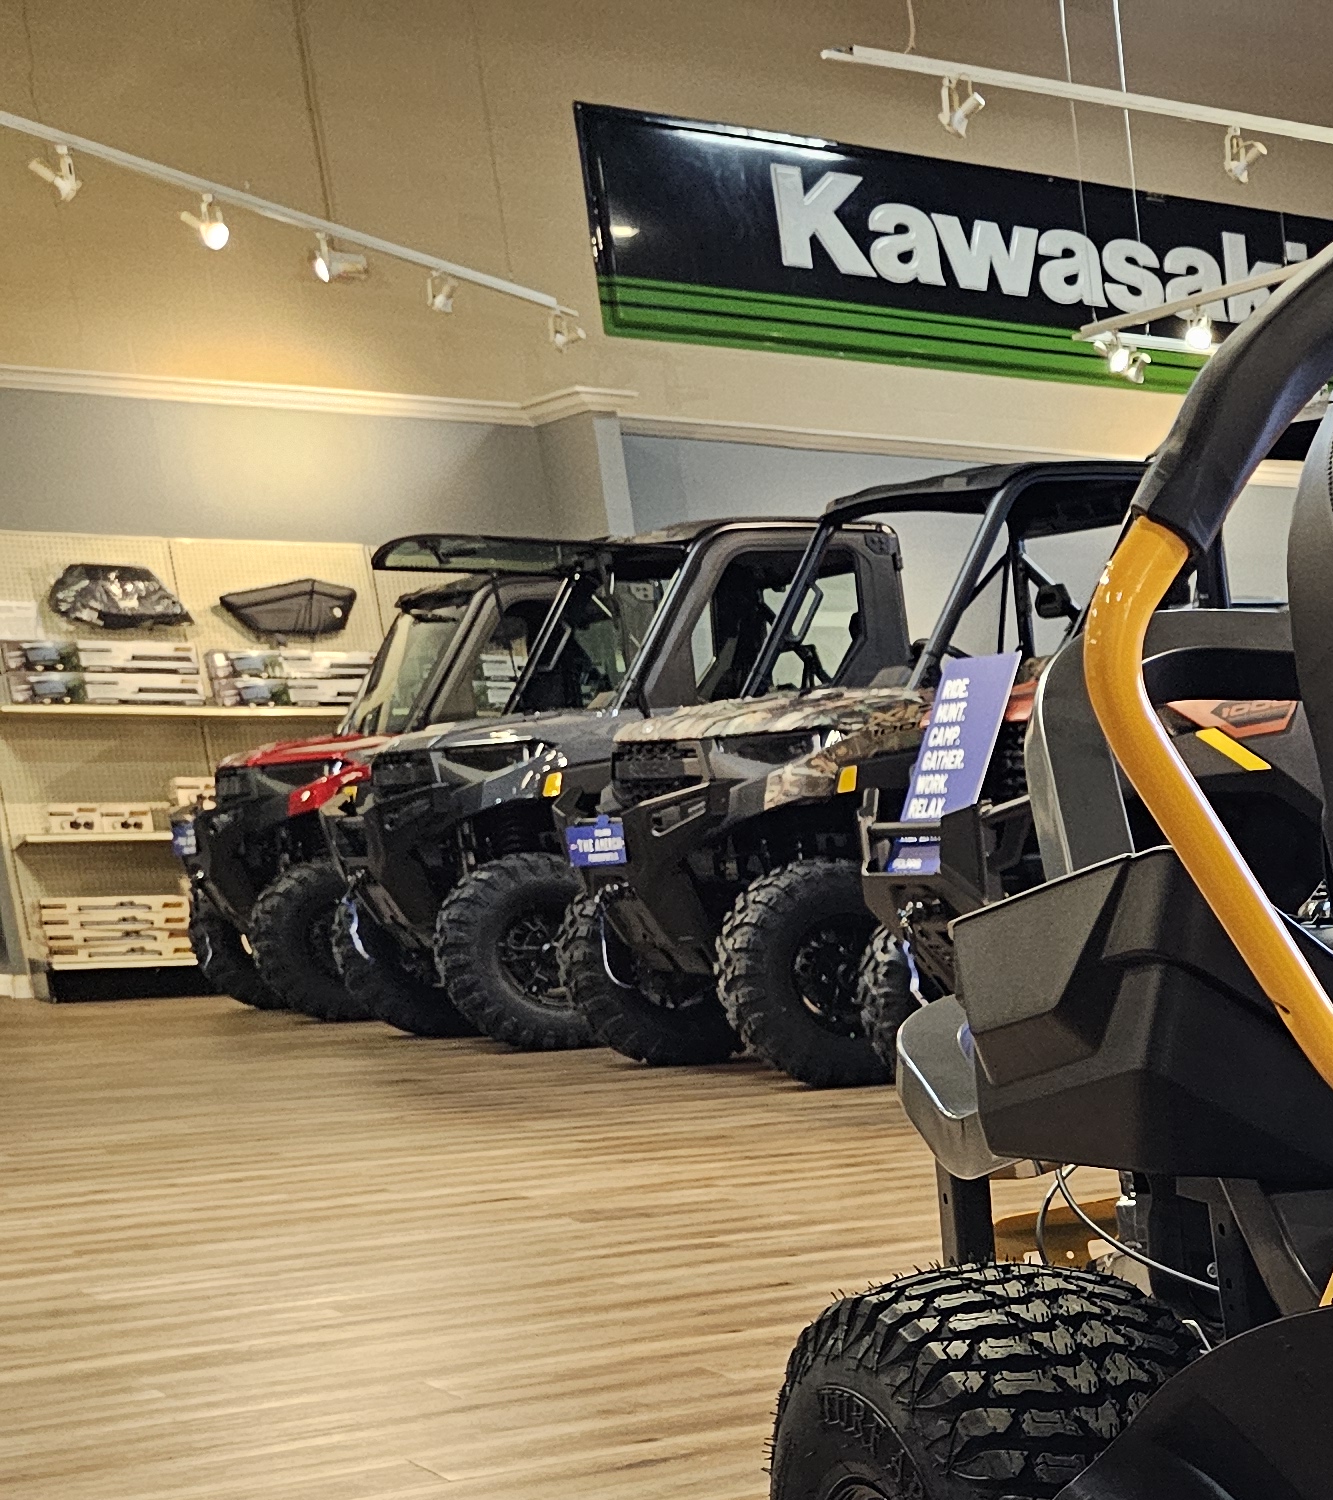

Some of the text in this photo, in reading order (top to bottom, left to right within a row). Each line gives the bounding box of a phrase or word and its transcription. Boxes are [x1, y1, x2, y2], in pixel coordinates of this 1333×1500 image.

[770, 163, 1308, 324] Kawasak
[942, 678, 970, 700] RIDE.
[935, 702, 966, 724] HUNT.
[928, 726, 961, 748] CAMP.
[921, 749, 965, 772] GATHER.
[915, 774, 948, 795] WORK.
[908, 797, 944, 819] RELAX.
